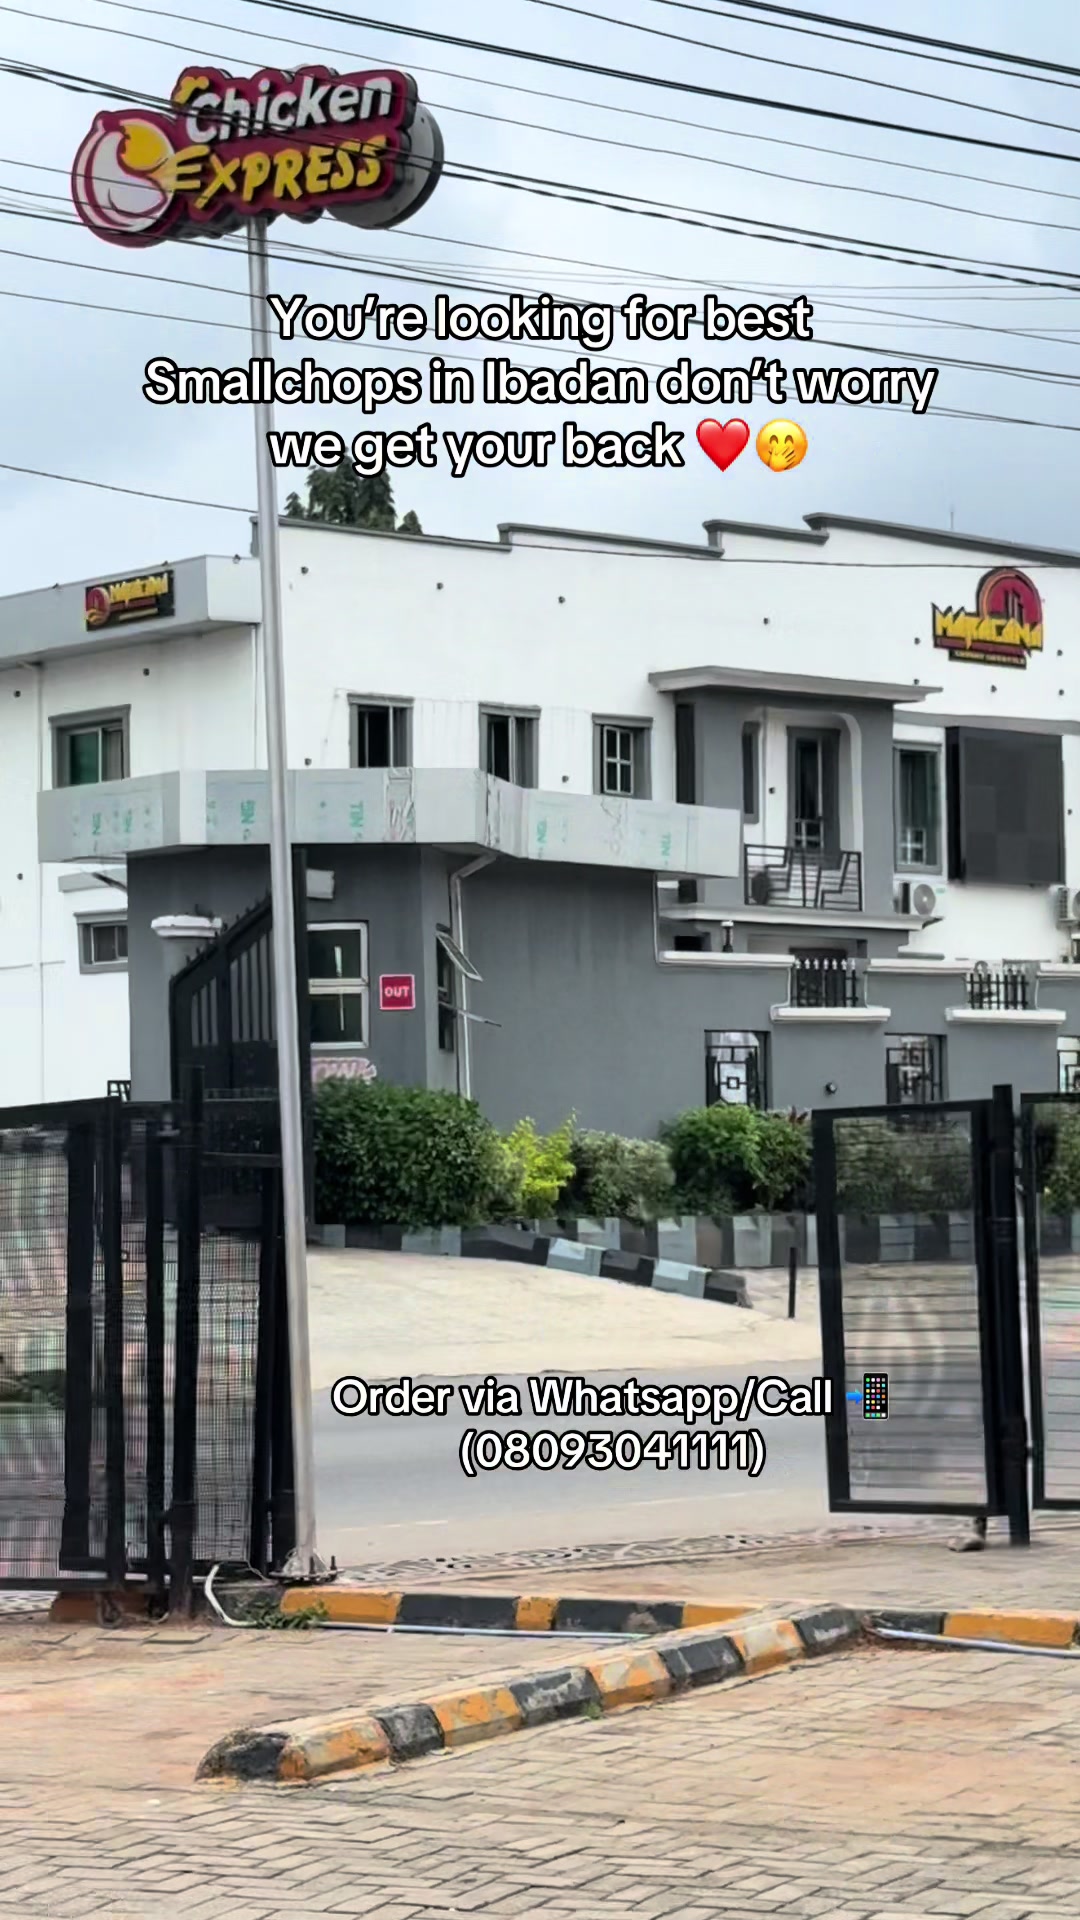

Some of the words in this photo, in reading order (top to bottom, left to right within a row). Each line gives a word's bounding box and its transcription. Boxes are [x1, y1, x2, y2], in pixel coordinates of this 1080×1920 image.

[186, 76, 392, 143] Chicken
[166, 135, 388, 208] EXPRESS
[384, 986, 410, 998] OUT
